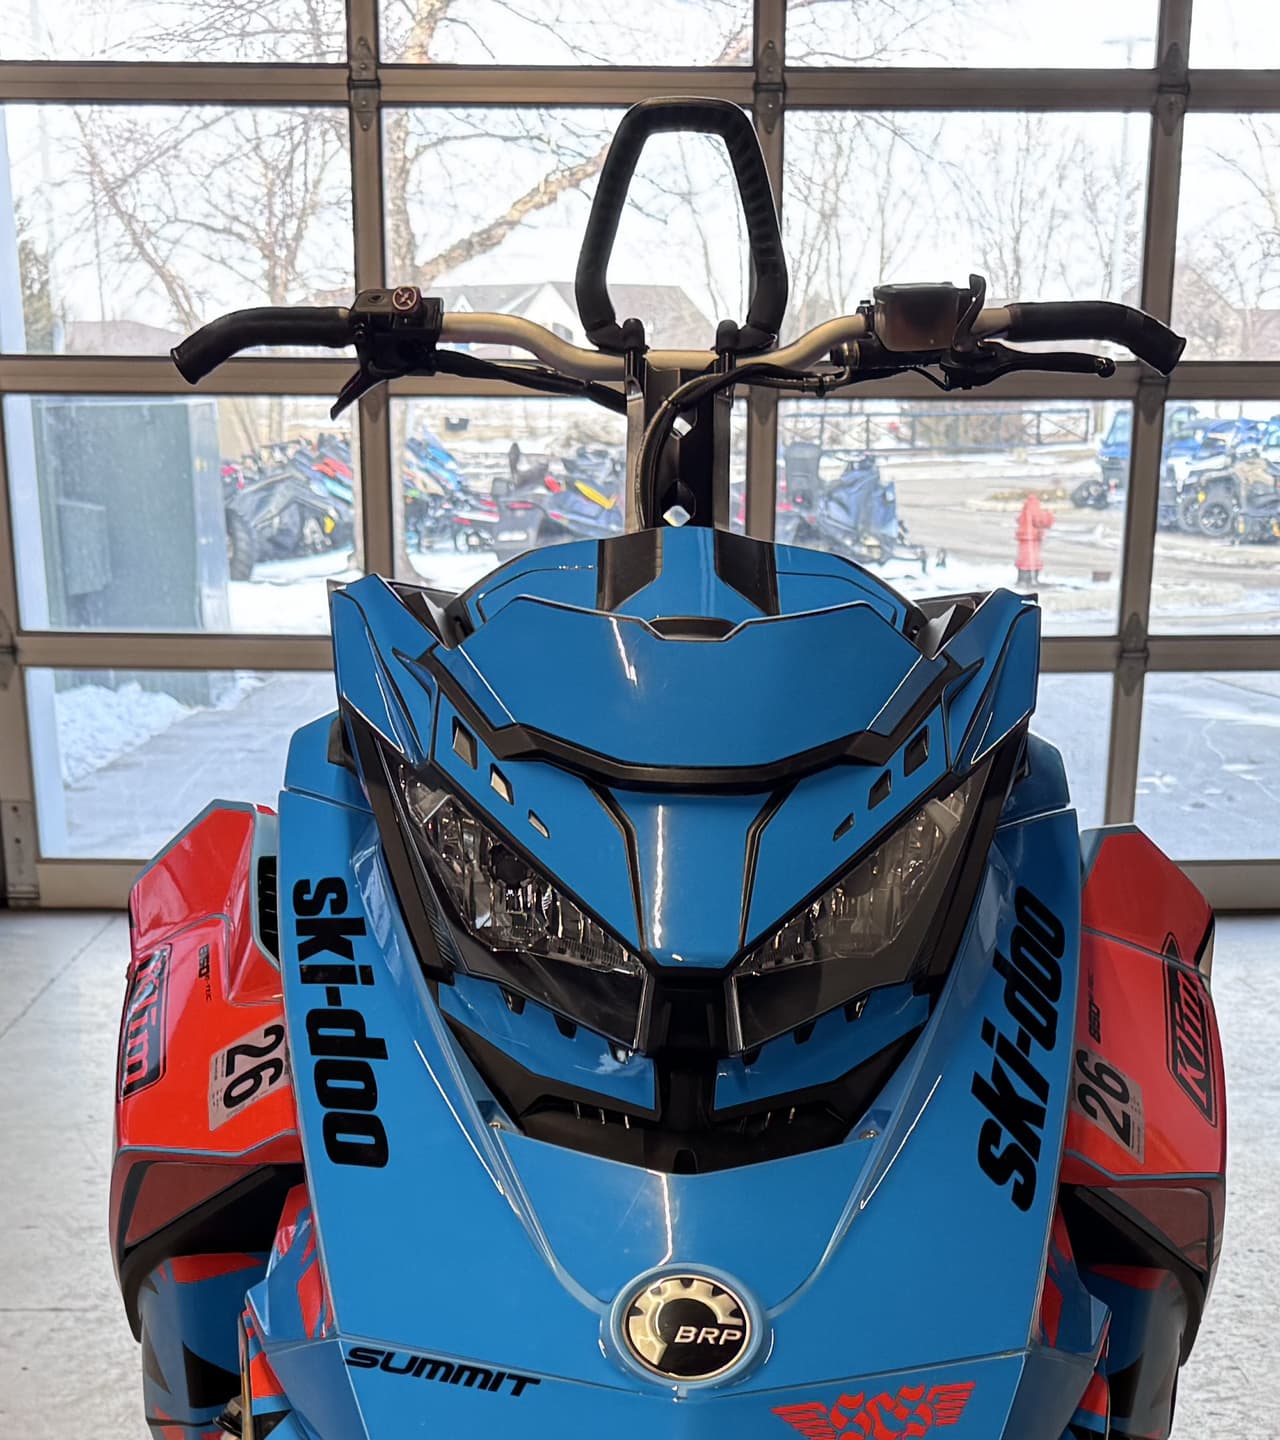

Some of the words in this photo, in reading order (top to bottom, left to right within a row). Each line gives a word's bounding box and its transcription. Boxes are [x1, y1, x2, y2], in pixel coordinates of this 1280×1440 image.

[223, 1024, 285, 1109] 26
[1076, 1050, 1131, 1149] 26
[674, 1325, 743, 1345] BRP
[345, 1346, 542, 1397] SUMMIT
